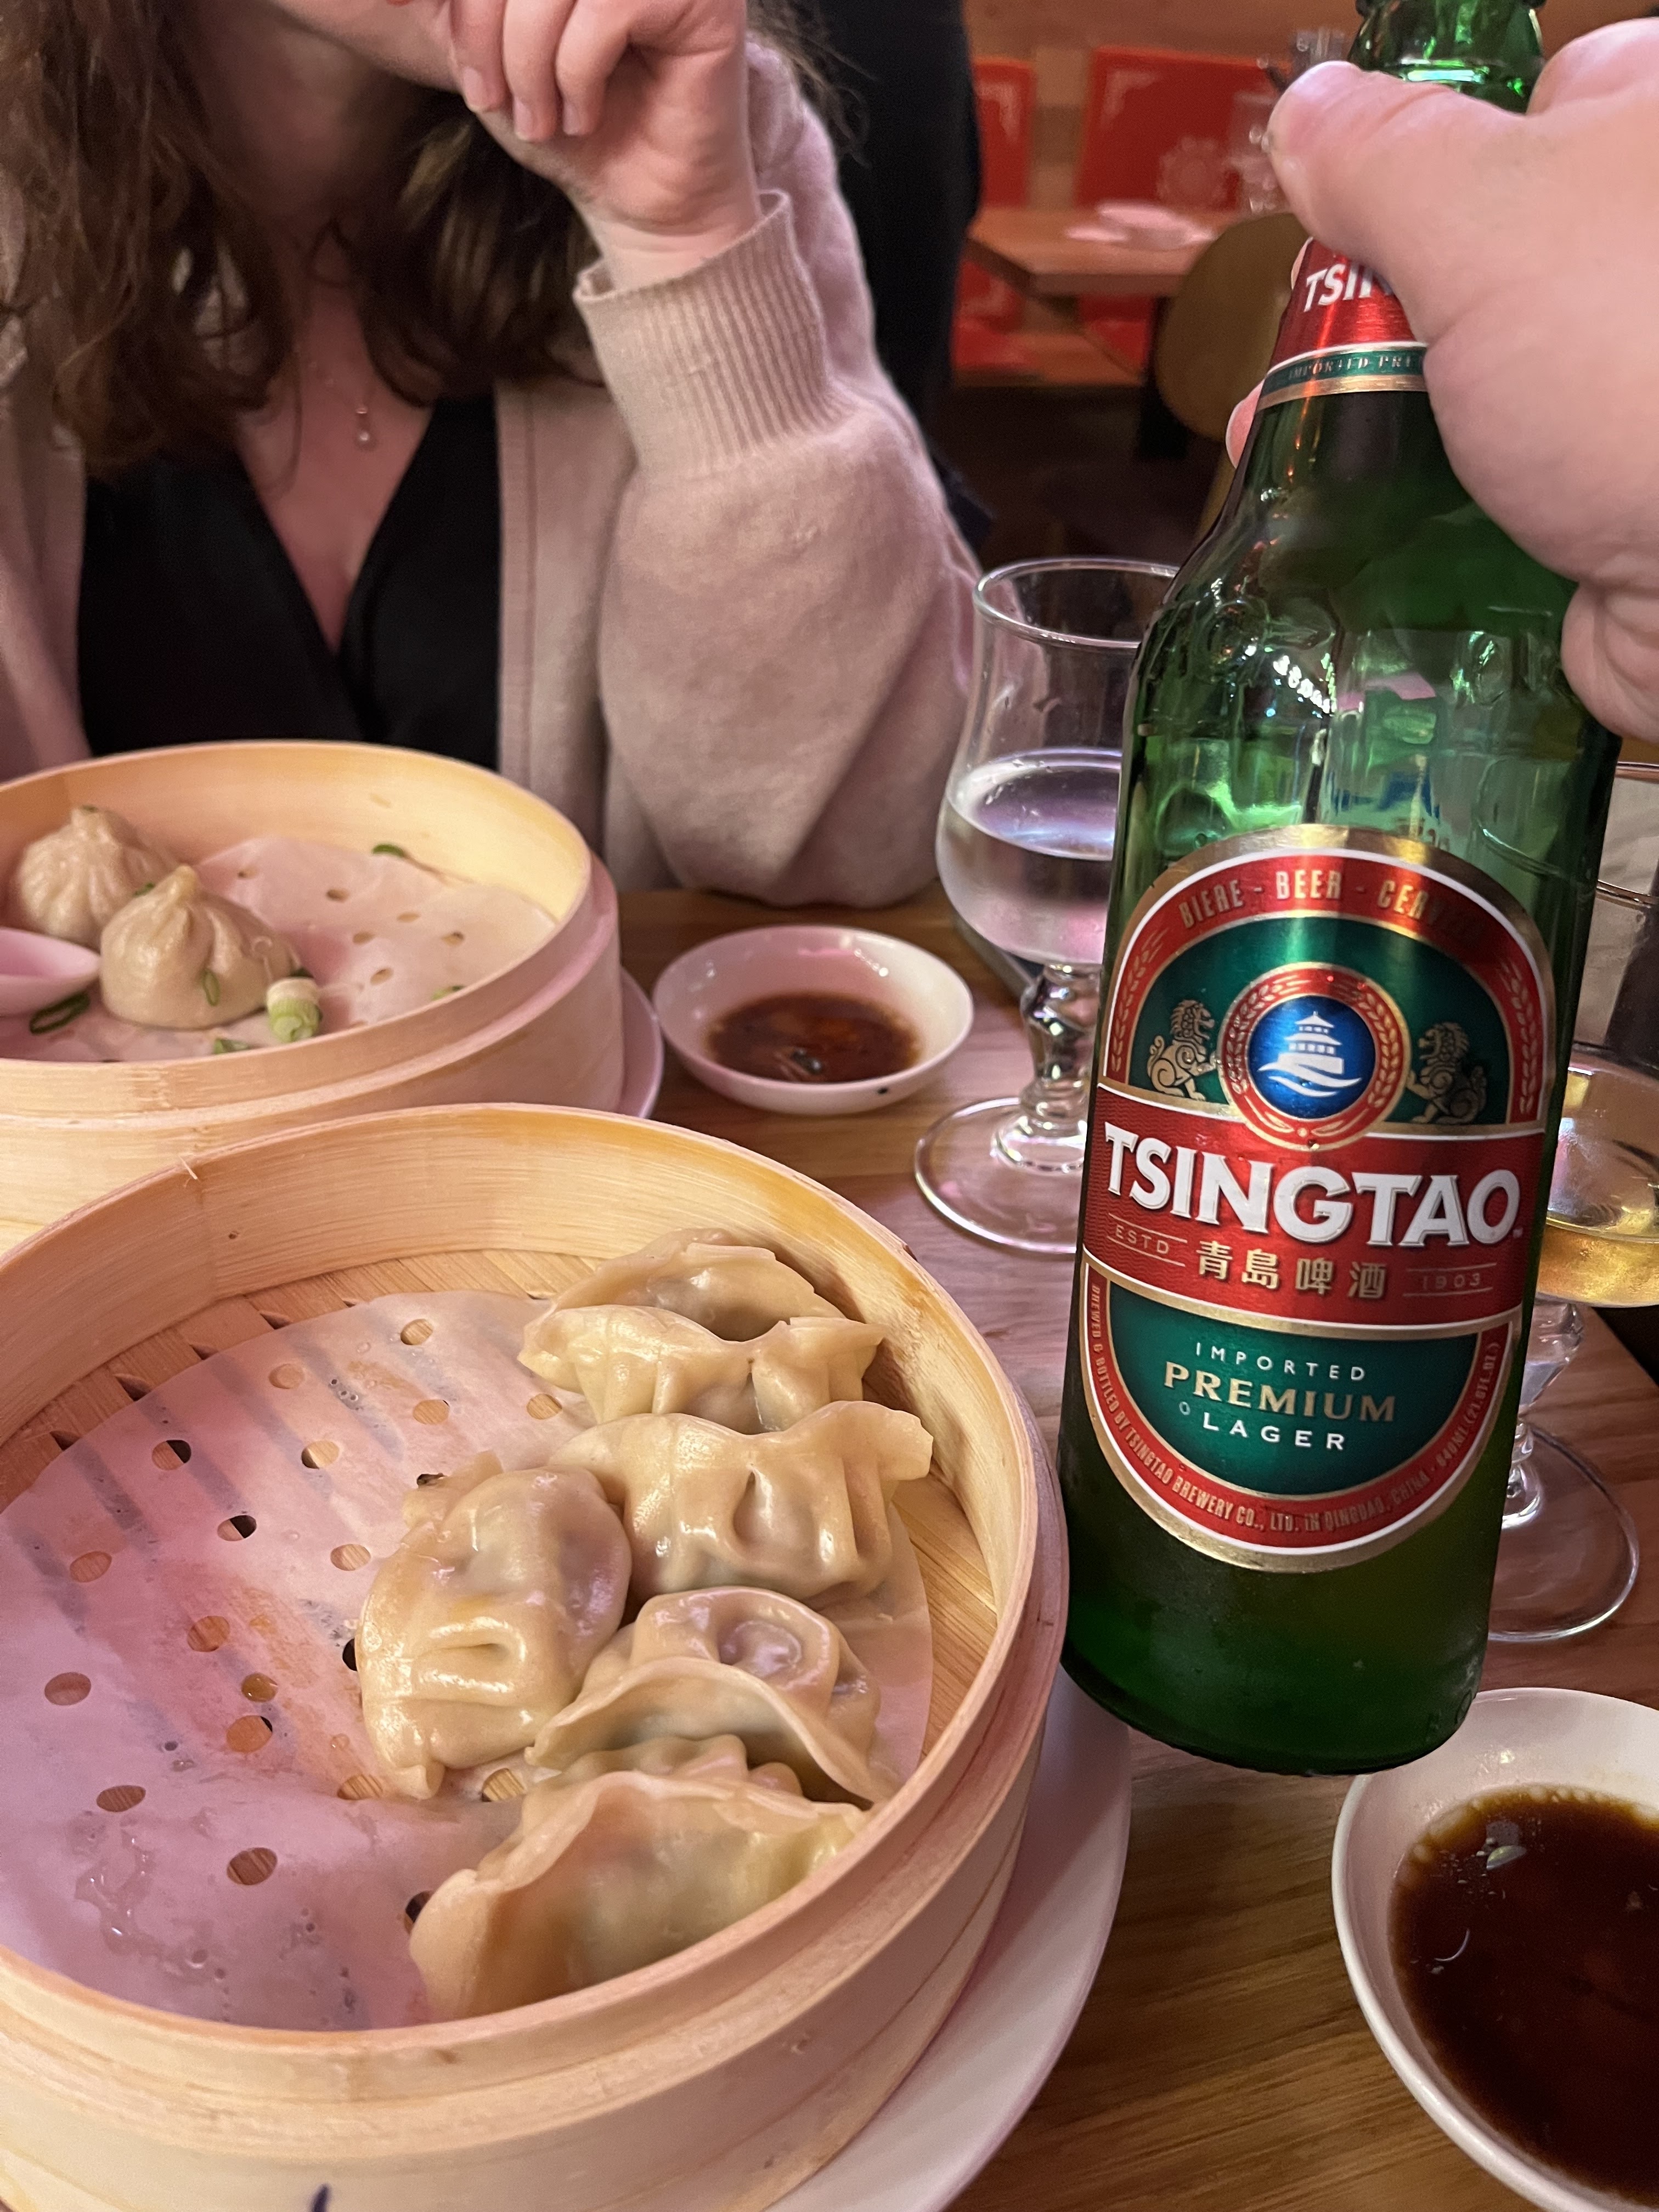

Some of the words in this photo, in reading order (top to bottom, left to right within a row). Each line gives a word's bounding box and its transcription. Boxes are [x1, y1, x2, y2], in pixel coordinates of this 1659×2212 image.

[1276, 869, 1342, 900] BEER
[1104, 1121, 1521, 1248] TSINGTAO
[1114, 1224, 1171, 1255] ESTD
[1195, 1240, 1387, 1299] 青島啤酒
[1422, 1272, 1481, 1291] 1903
[1195, 1342, 1365, 1381] IMPORTED
[1164, 1361, 1395, 1422] PREMIUM
[1096, 1357, 1120, 1413] BOTTLED
[1114, 1410, 1132, 1431] BY
[1125, 1427, 1174, 1485] TSINGTAO
[1172, 1475, 1234, 1520] BREWERY
[1390, 1470, 1431, 1506] CHINA
[1203, 1412, 1345, 1451] LAGER
